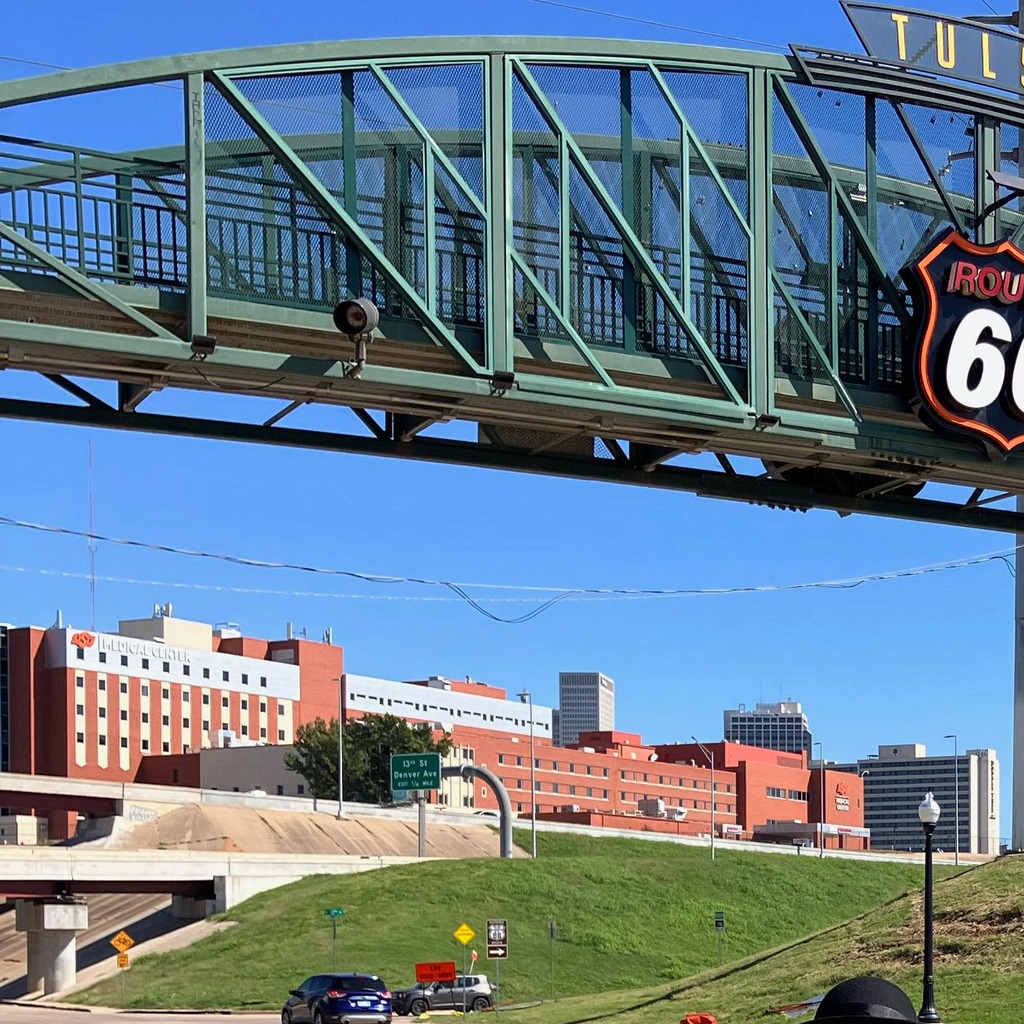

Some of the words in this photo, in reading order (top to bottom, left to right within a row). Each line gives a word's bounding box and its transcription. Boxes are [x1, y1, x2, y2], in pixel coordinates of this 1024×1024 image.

[102, 638, 149, 656] MEDICAL
[151, 648, 191, 663] CENTER
[419, 759, 428, 767] St
[393, 771, 420, 779] Denver
[423, 770, 437, 778] Ave
